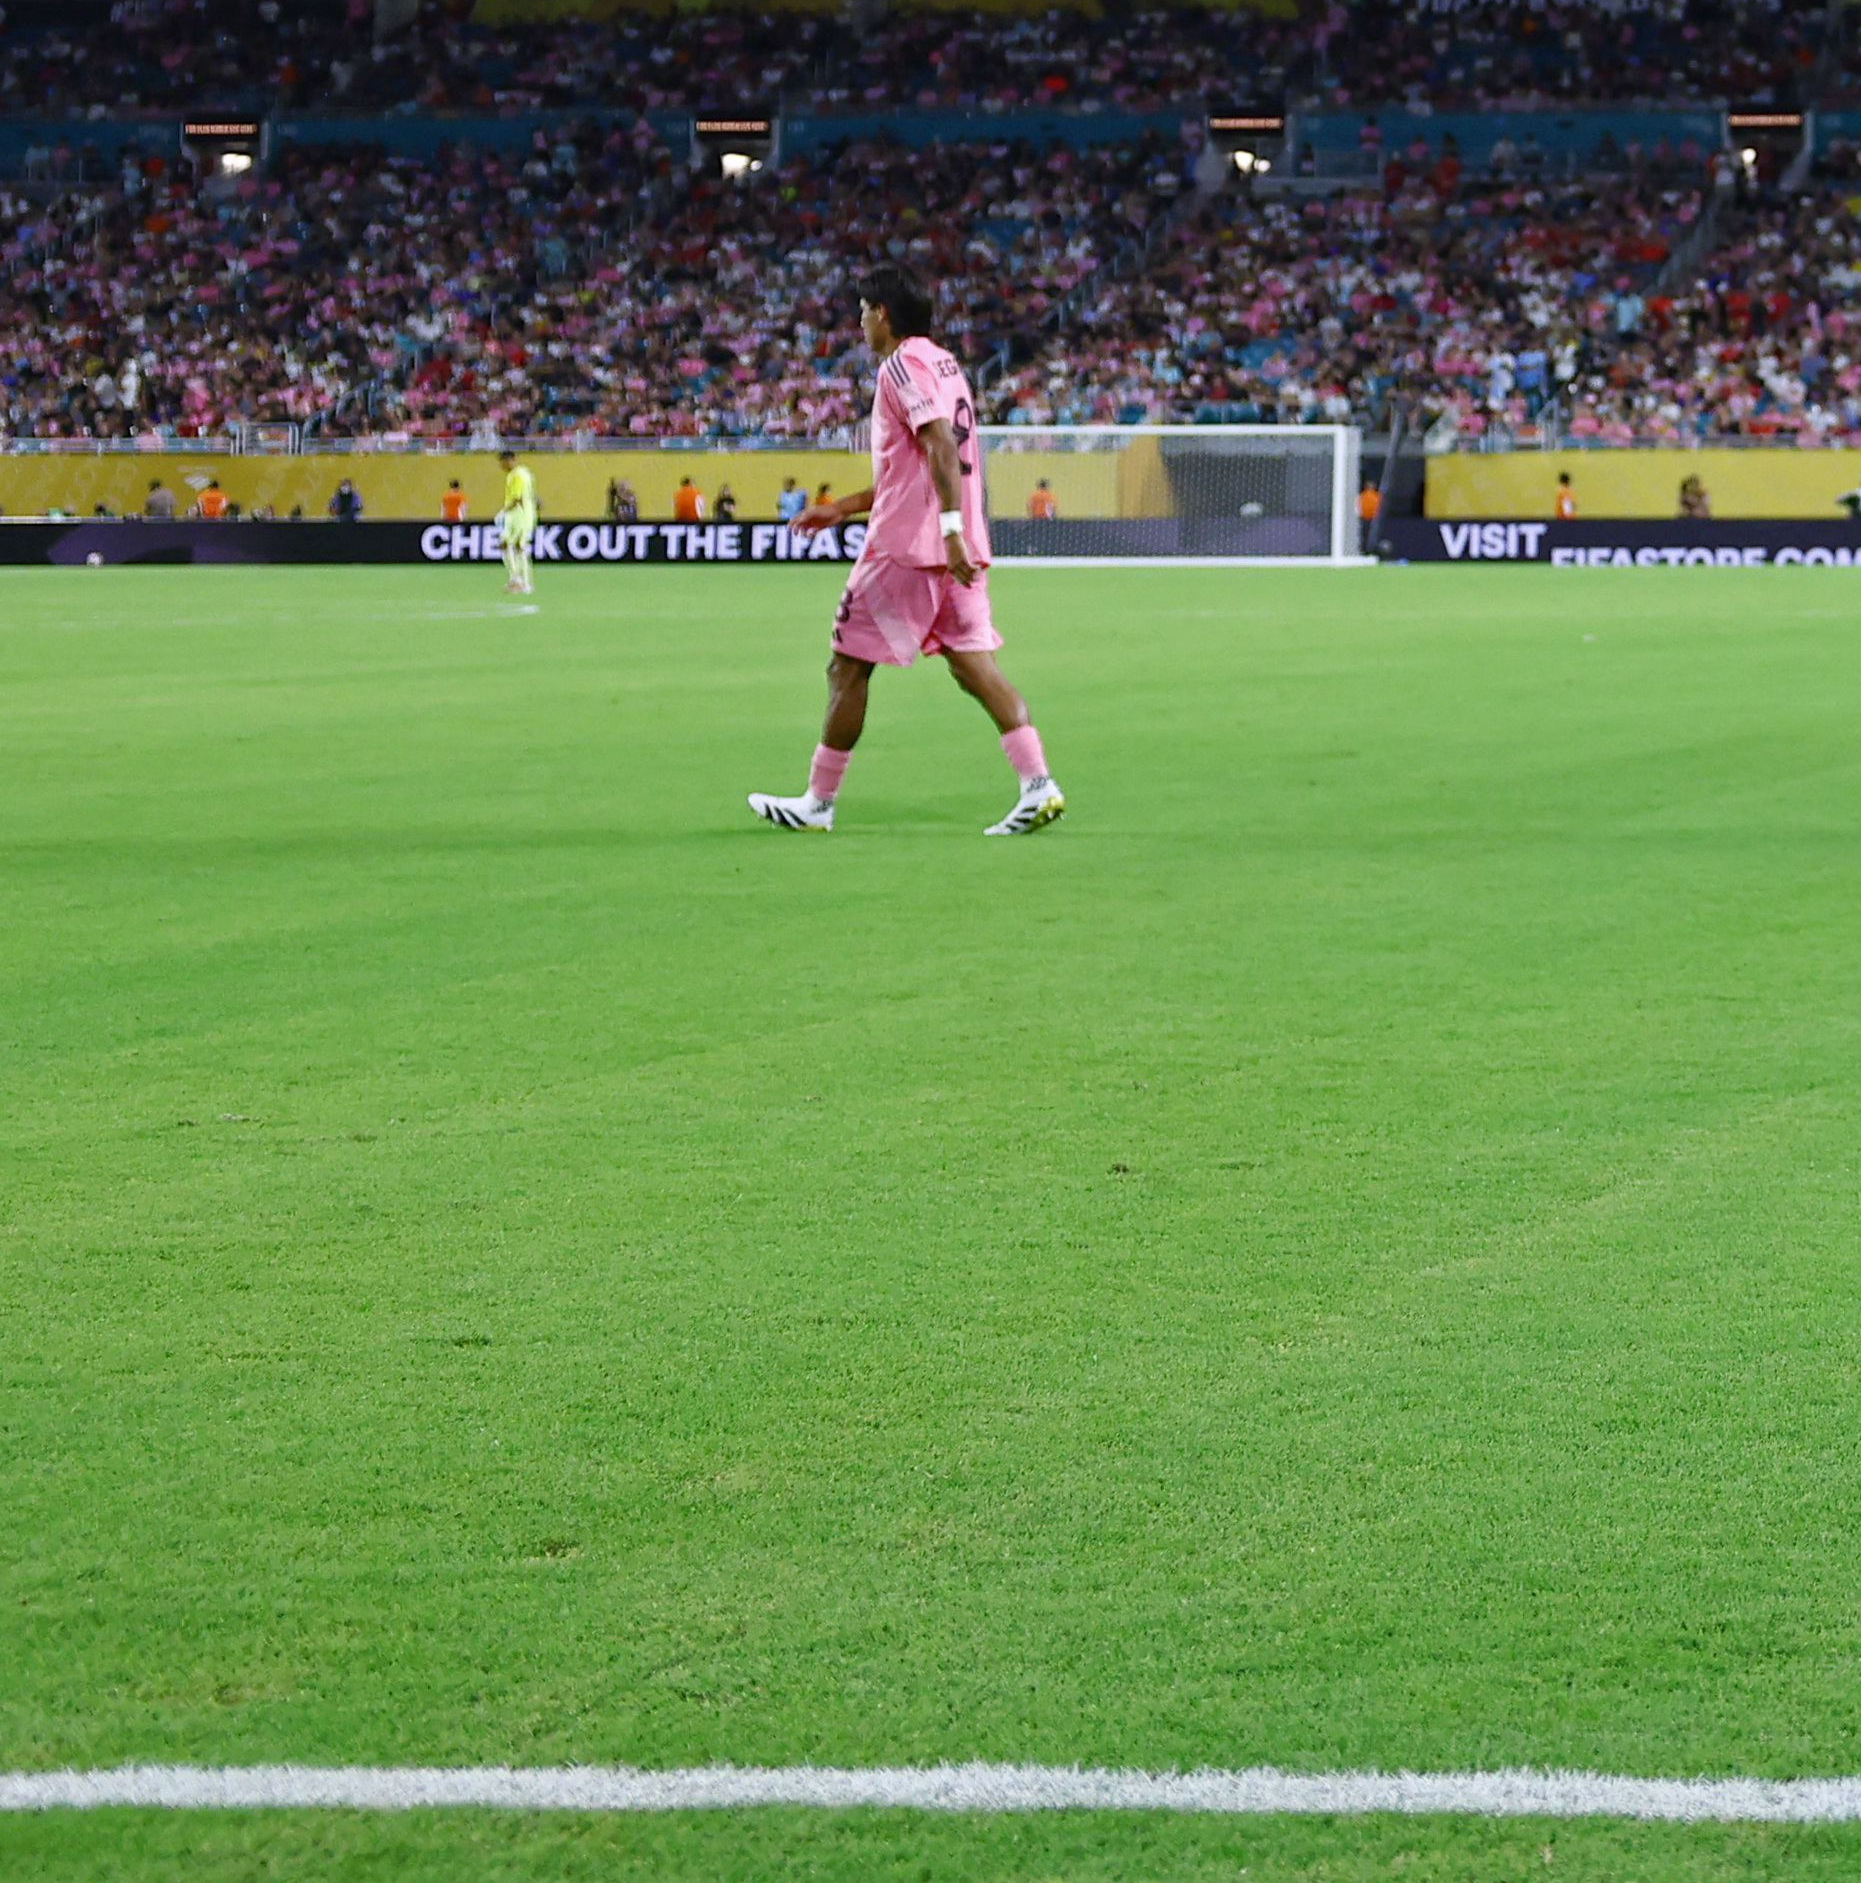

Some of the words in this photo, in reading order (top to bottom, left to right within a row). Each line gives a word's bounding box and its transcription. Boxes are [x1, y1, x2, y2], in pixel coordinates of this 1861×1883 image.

[421, 525, 564, 561] CHEK
[566, 524, 657, 560] OUT
[659, 524, 742, 561] THE
[751, 524, 843, 561] FIFA
[1438, 523, 1548, 559] VISIT
